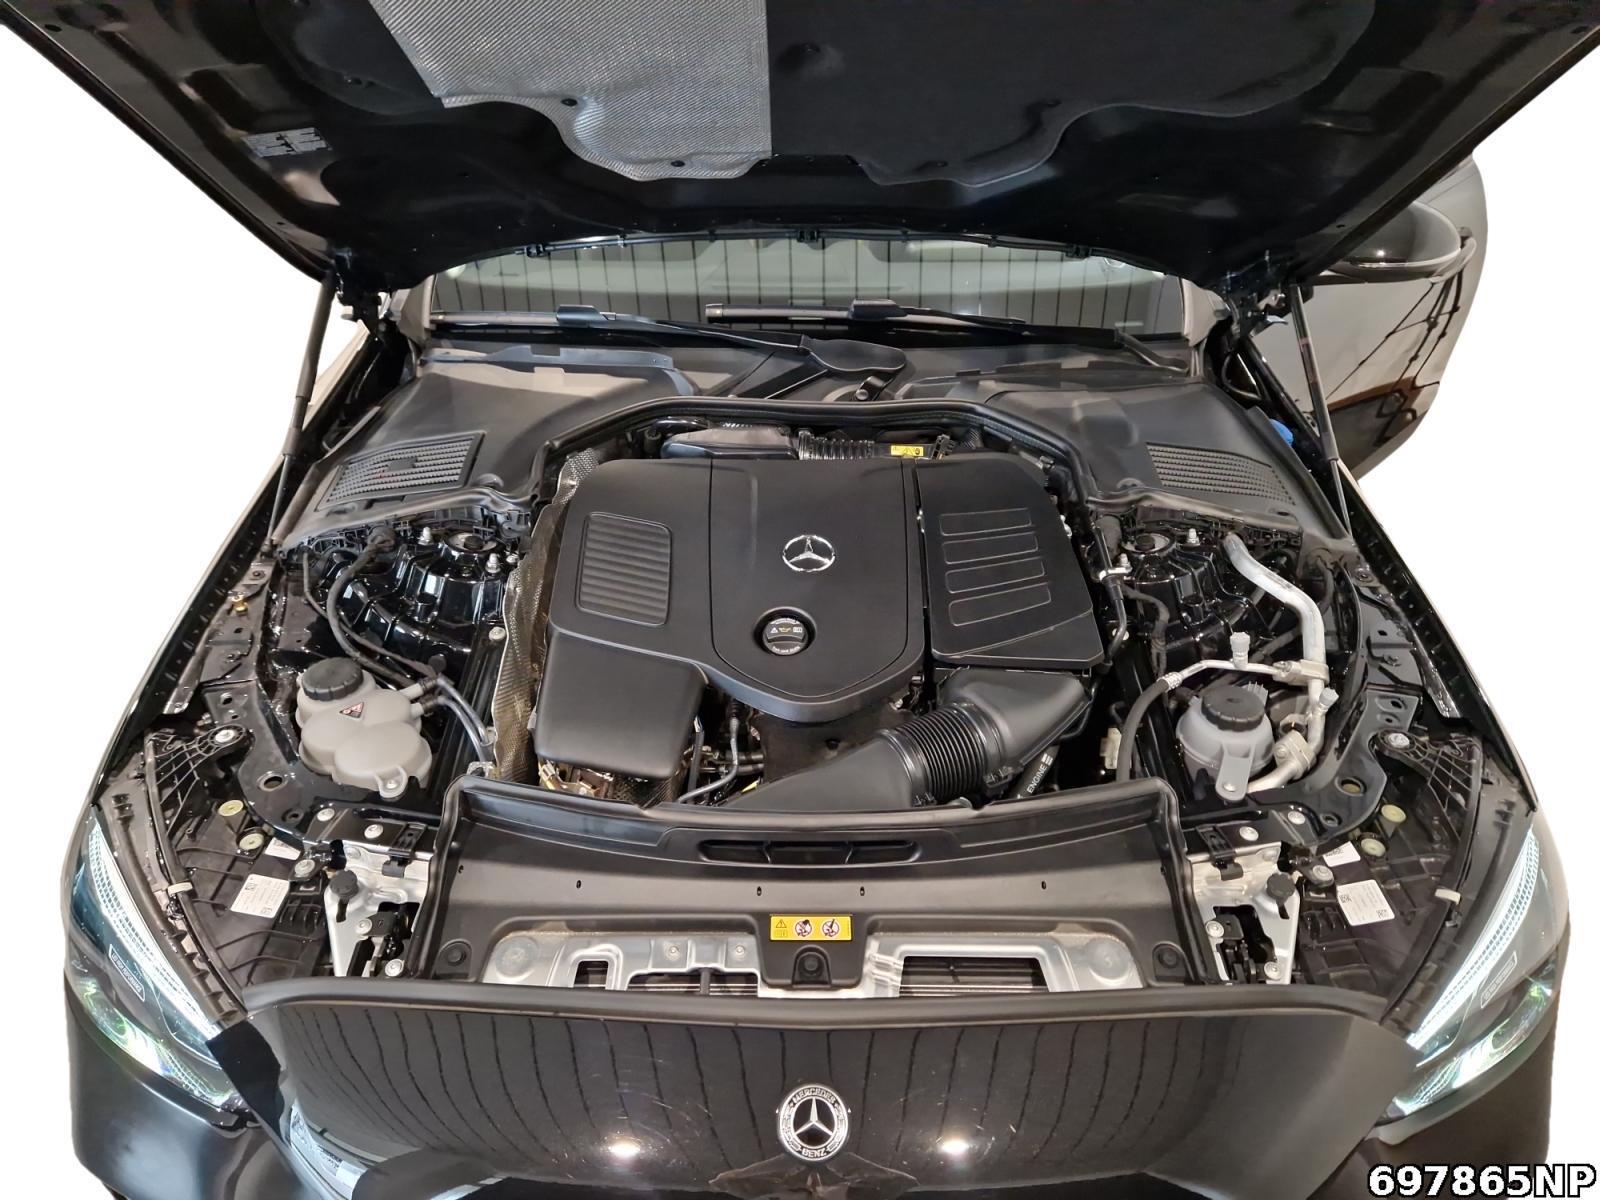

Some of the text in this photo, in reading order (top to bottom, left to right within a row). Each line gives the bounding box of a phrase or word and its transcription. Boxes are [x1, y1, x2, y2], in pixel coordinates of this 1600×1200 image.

[1027, 764, 1047, 793] ENGINE
[792, 1088, 836, 1104] MERCEDES
[801, 1147, 827, 1158] BENZ
